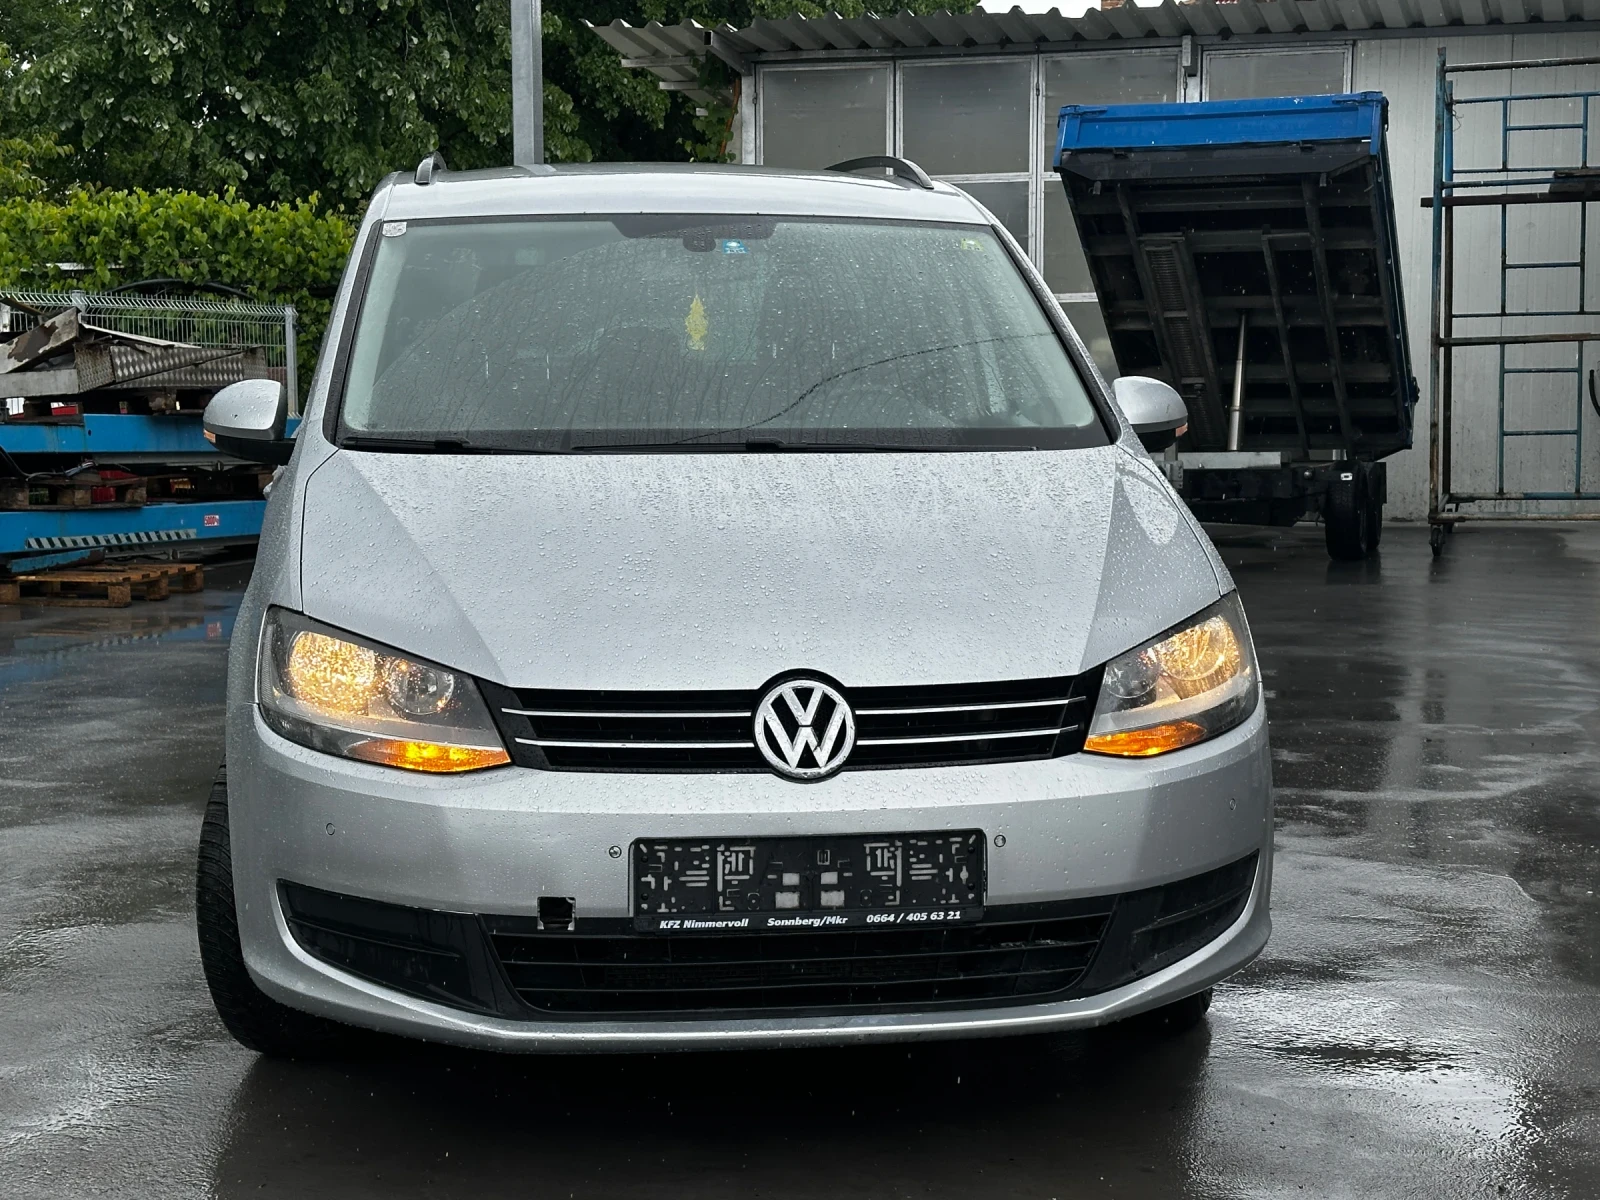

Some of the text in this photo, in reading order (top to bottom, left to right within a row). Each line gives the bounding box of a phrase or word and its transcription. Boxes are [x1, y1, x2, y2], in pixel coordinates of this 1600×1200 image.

[755, 680, 855, 778] VW
[660, 920, 681, 929] KFZ
[683, 918, 749, 929] Nimmervoll
[767, 916, 848, 928] Sonnberg/Mkr
[866, 914, 895, 923] 0664
[906, 913, 928, 922] 405
[930, 911, 944, 921] 63
[946, 911, 961, 920] 21
